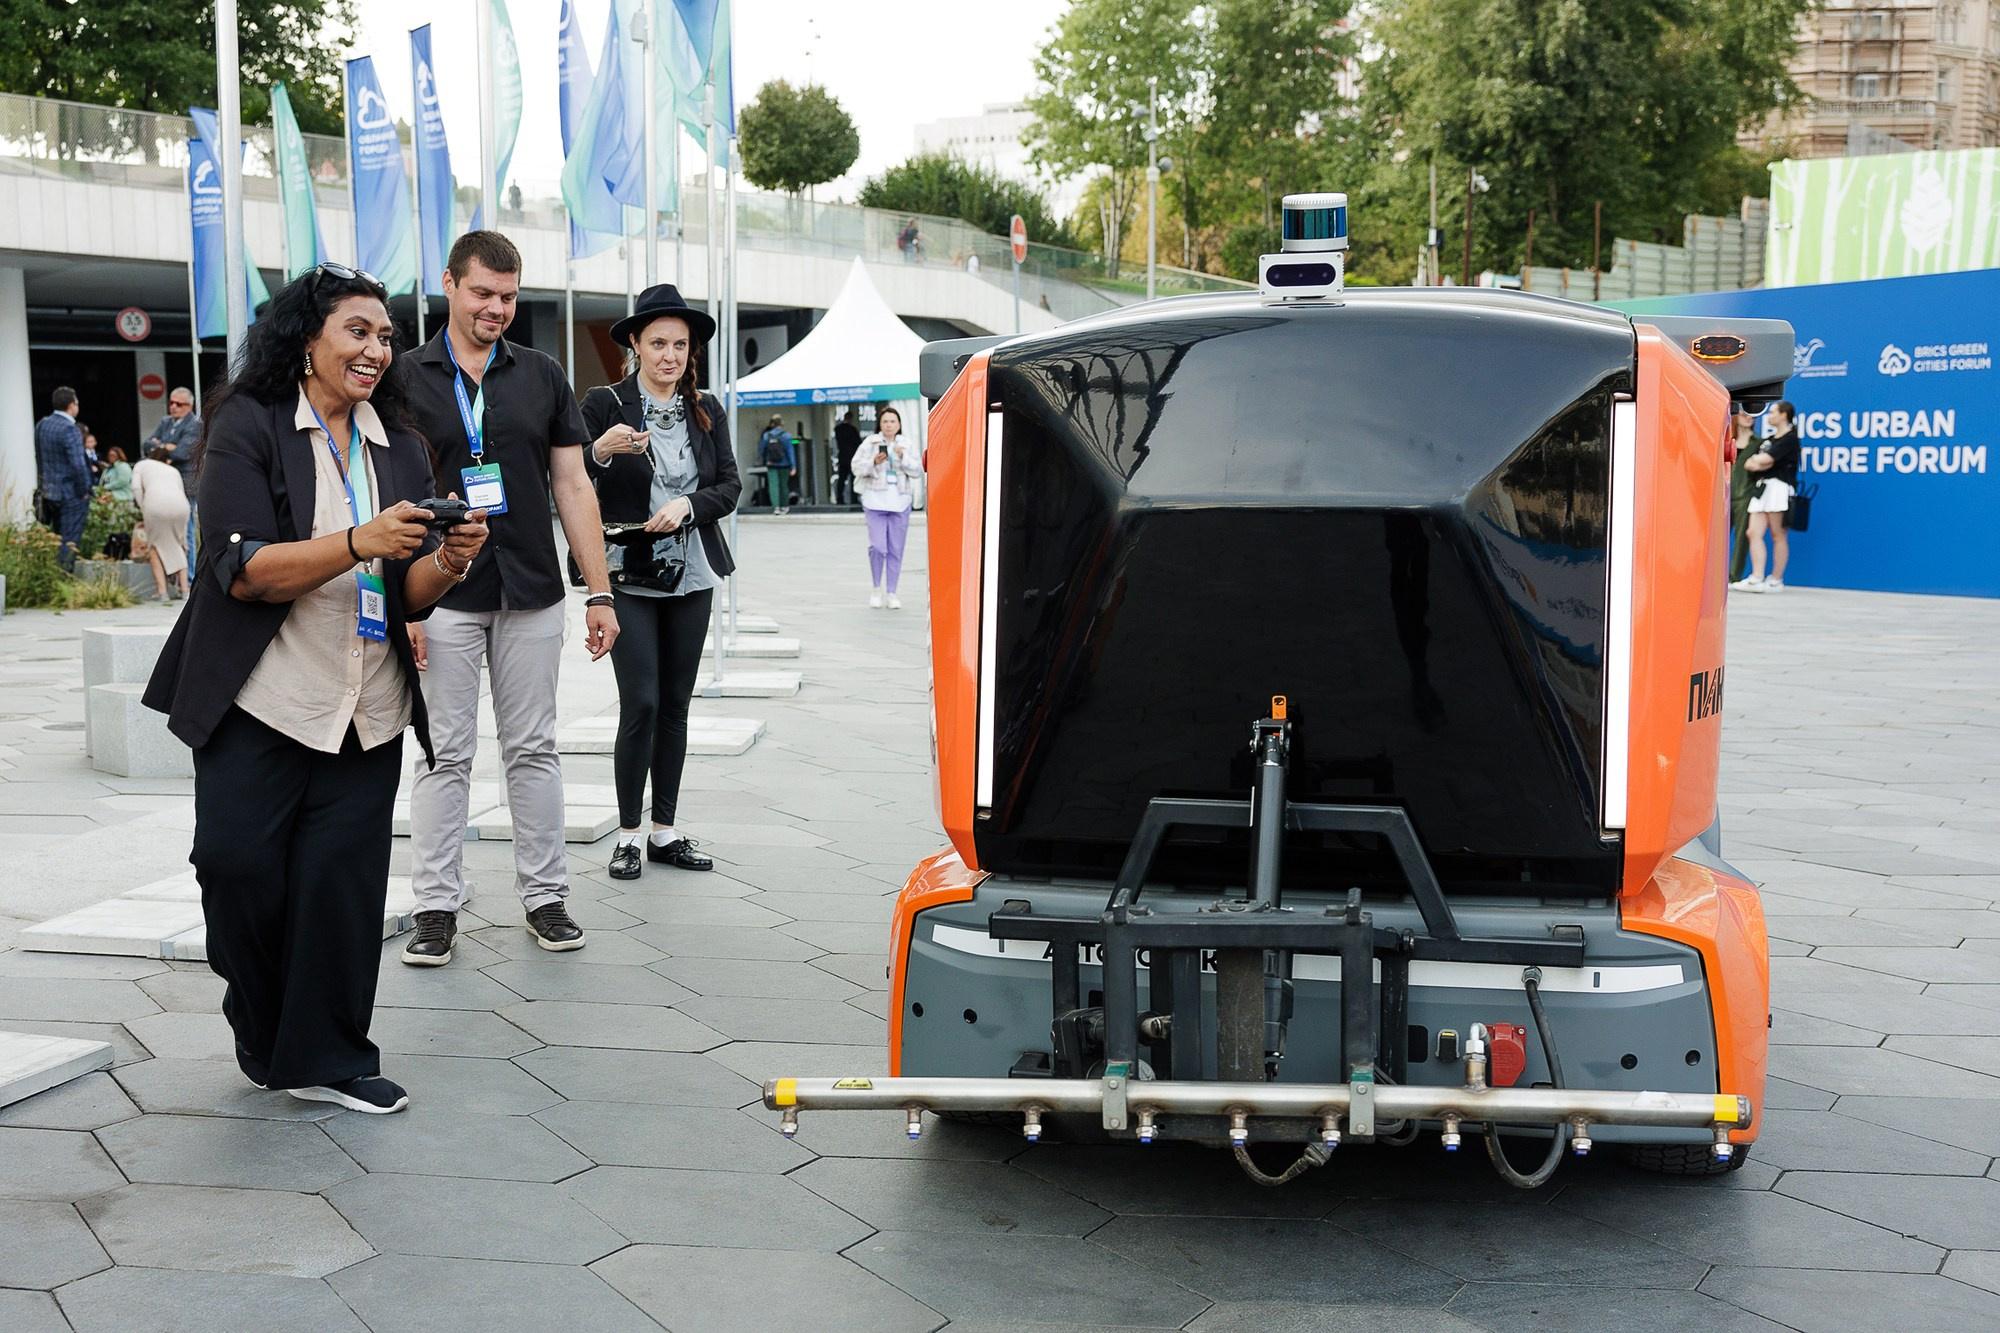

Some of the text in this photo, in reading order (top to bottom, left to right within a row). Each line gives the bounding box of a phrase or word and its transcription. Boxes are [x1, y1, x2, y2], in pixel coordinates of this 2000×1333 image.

[1914, 342, 1988, 358] BRICS GREEN
[1913, 357, 1991, 372] CITIES FORUM
[1761, 409, 1955, 439] BICS URBAN
[1800, 446, 1987, 474] TURE FORUM
